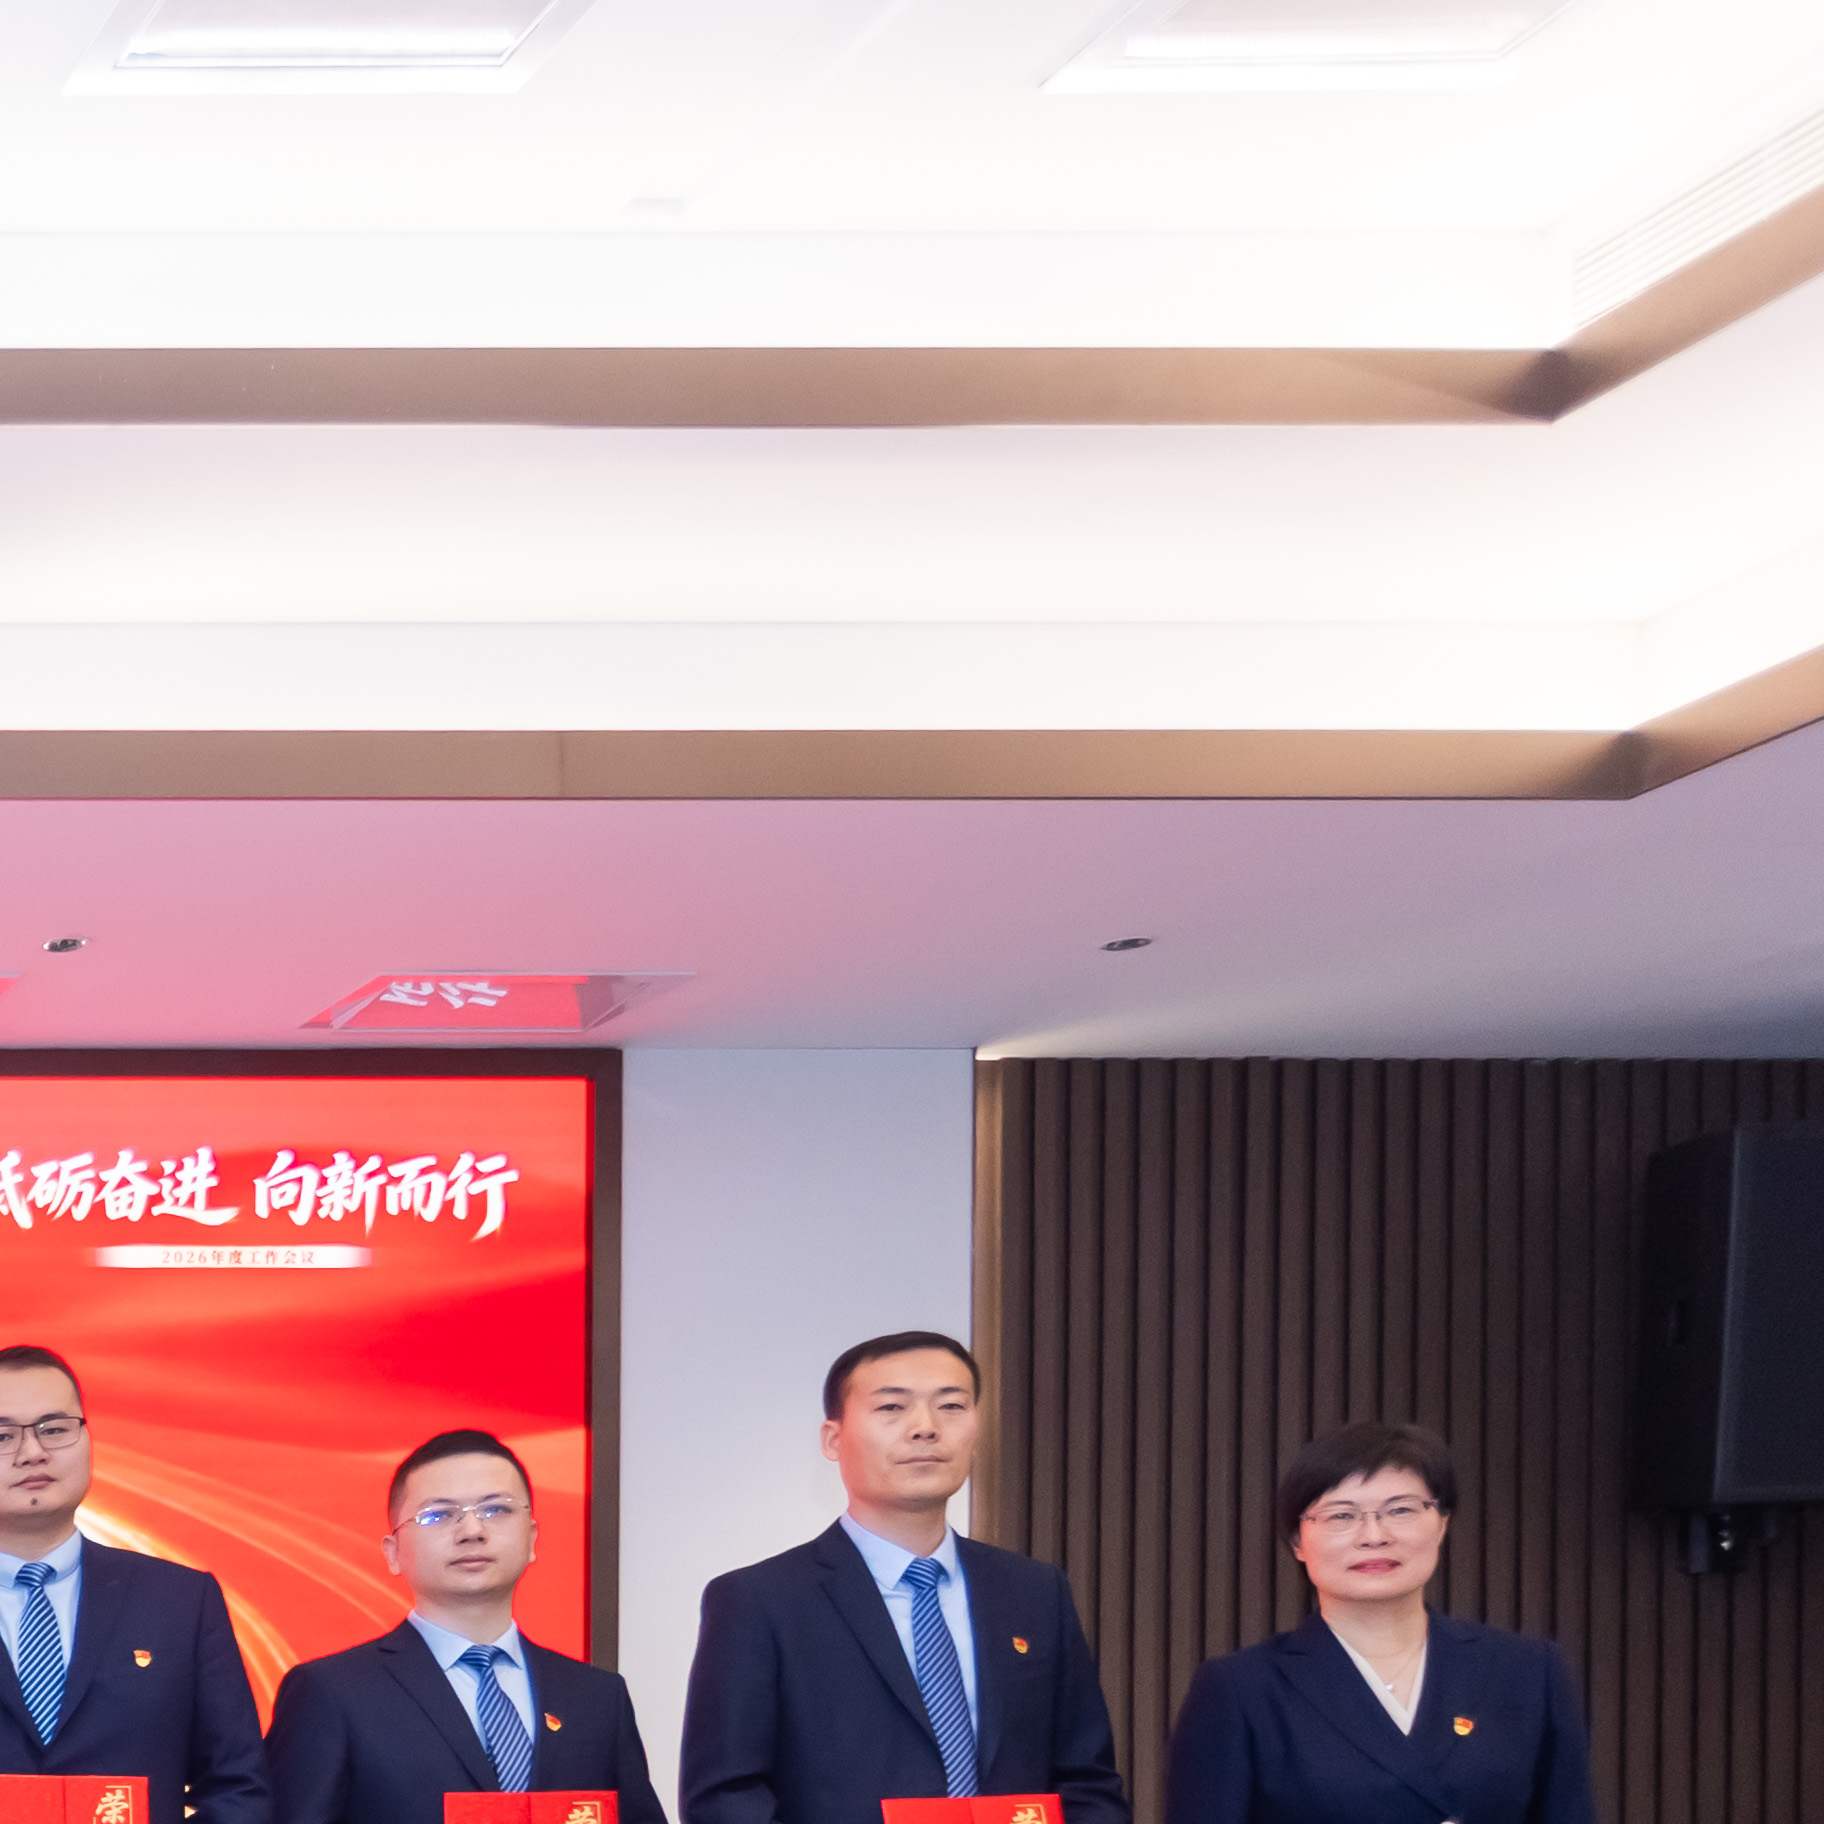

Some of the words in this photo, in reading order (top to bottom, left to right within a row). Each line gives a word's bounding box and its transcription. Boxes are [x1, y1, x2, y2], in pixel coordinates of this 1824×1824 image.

[252, 1149, 520, 1241] 向新而行
[161, 1250, 314, 1265] 2026年度工作会议
